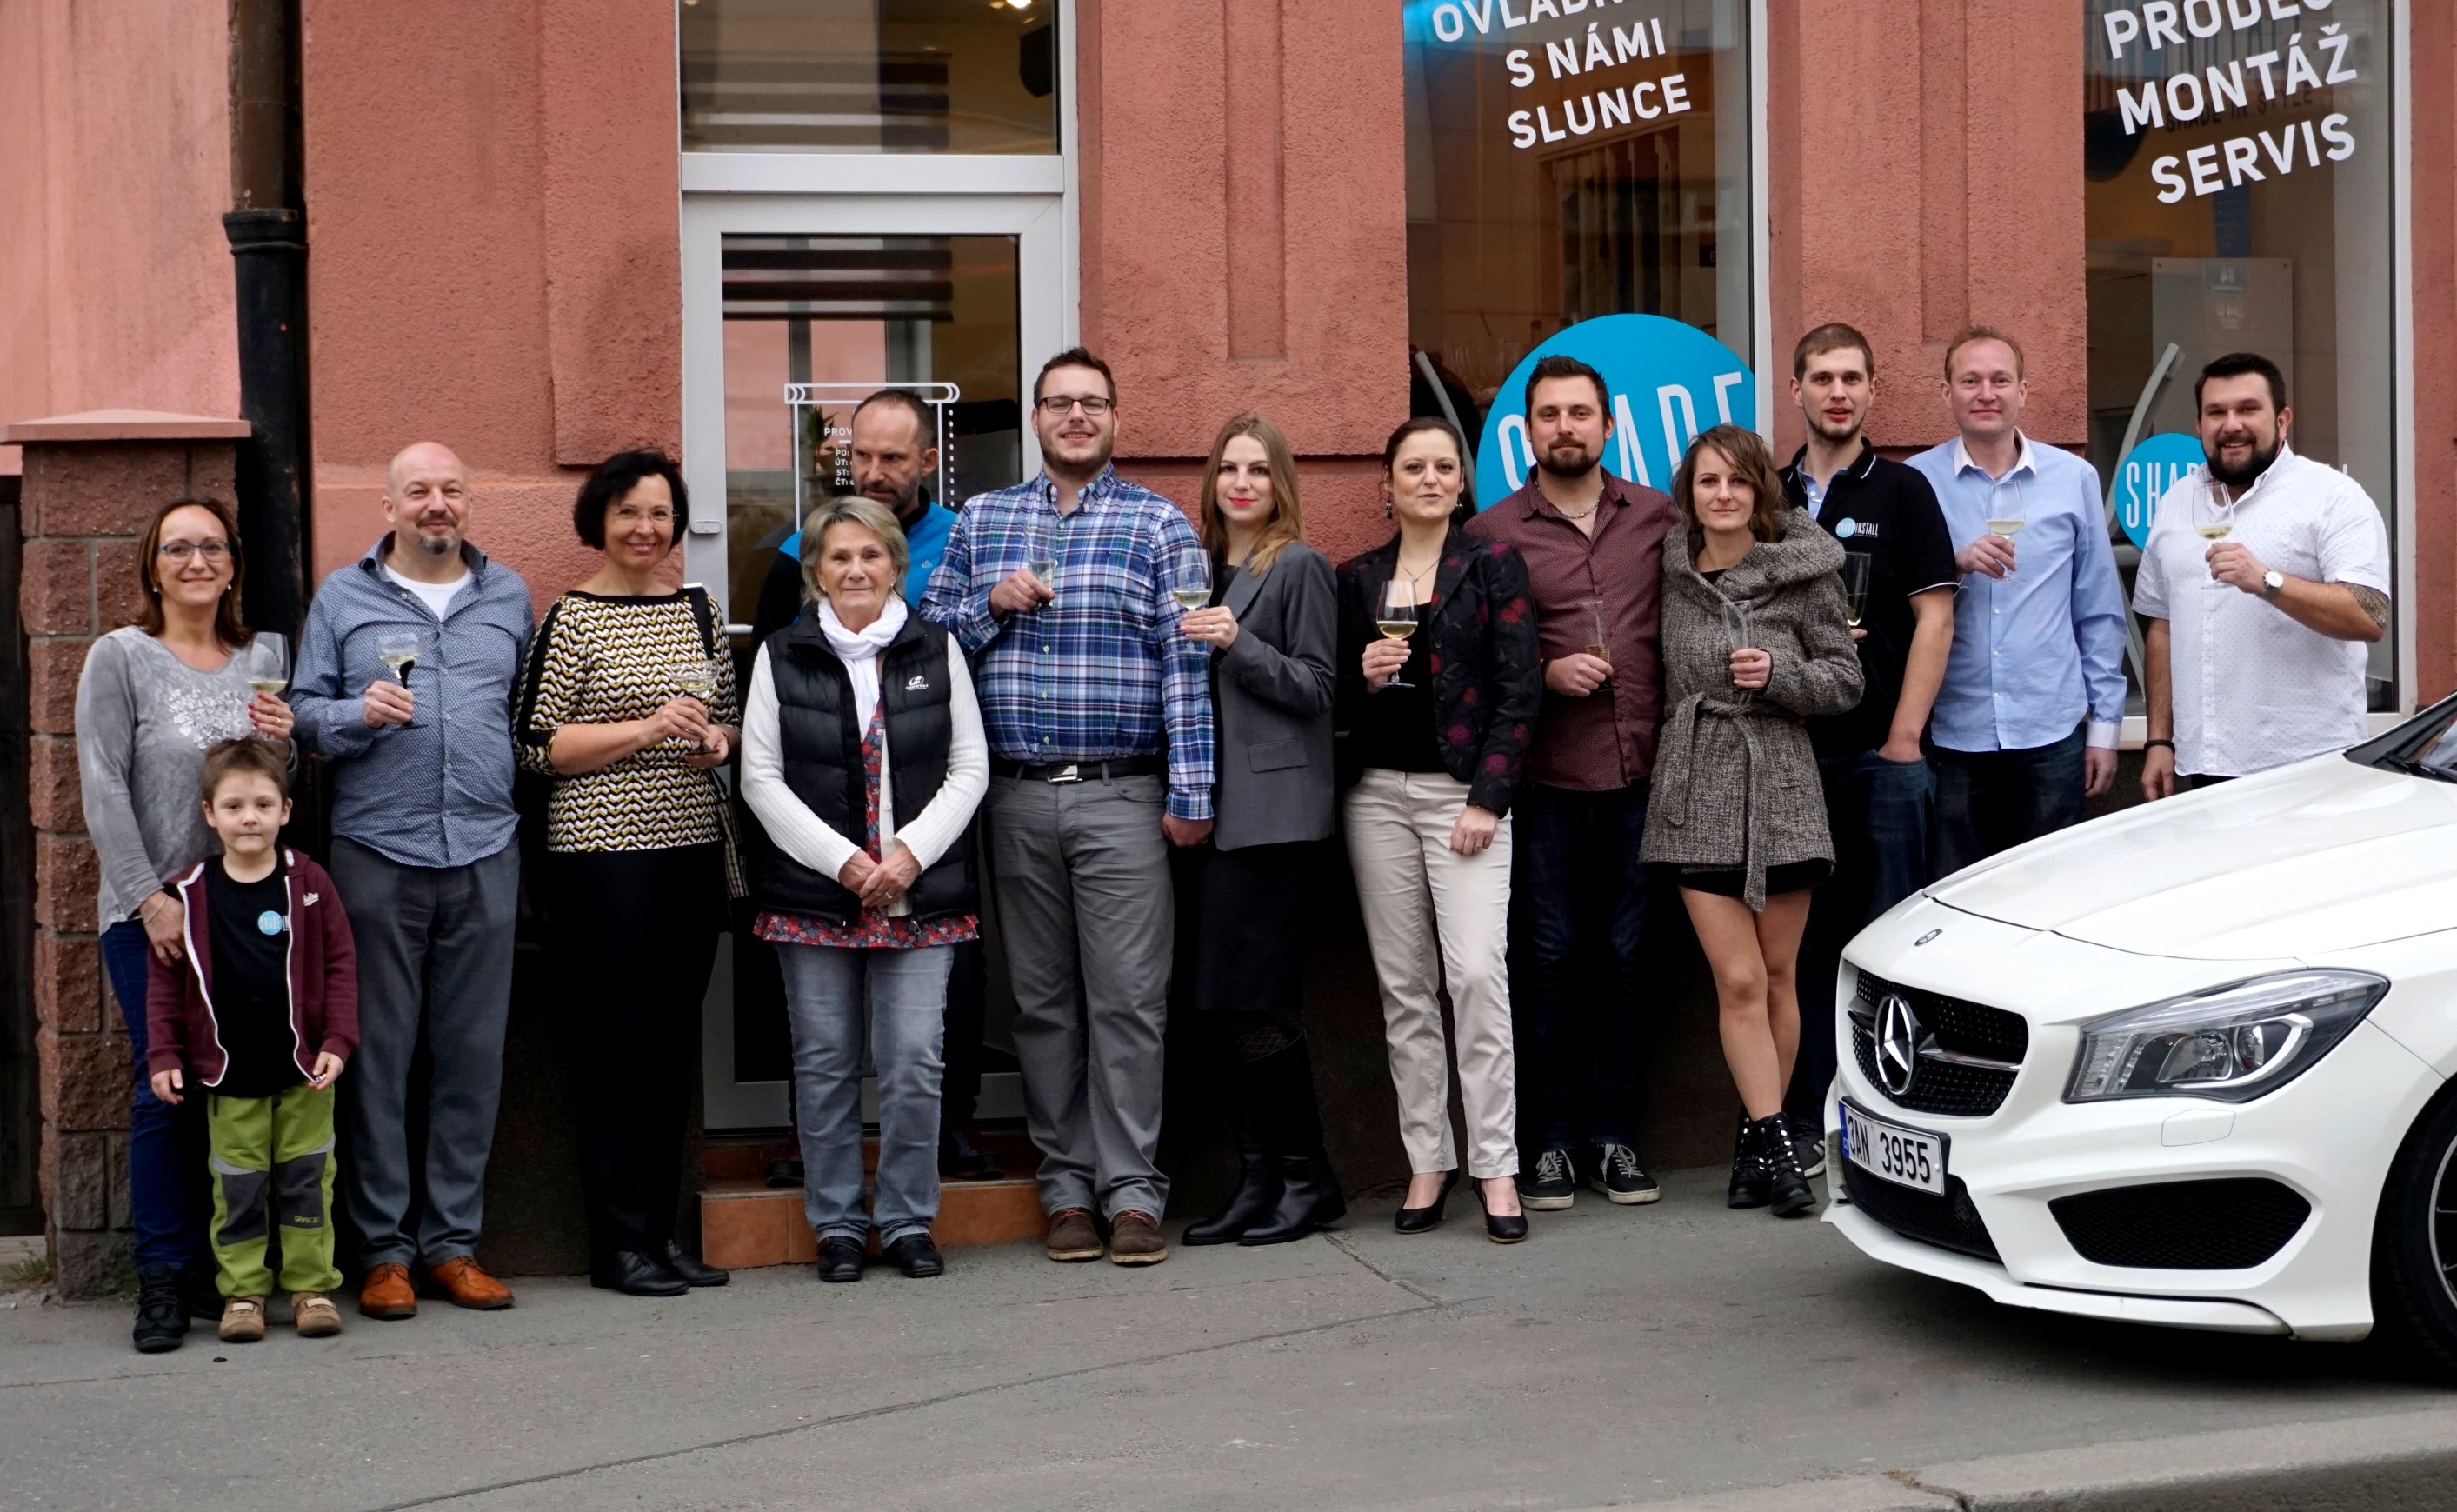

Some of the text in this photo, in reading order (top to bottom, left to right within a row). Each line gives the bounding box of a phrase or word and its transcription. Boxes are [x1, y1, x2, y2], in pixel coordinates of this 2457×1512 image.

[1506, 18, 1666, 87] S NÁMI
[2104, 0, 2333, 59] PRODE
[1508, 73, 1691, 148] SLUNCE
[2116, 23, 2357, 135] MONTÁŽ
[2151, 113, 2355, 203] SERVIS
[824, 427, 853, 436] PROV
[1848, 1115, 1930, 1183] 3AN 3955
